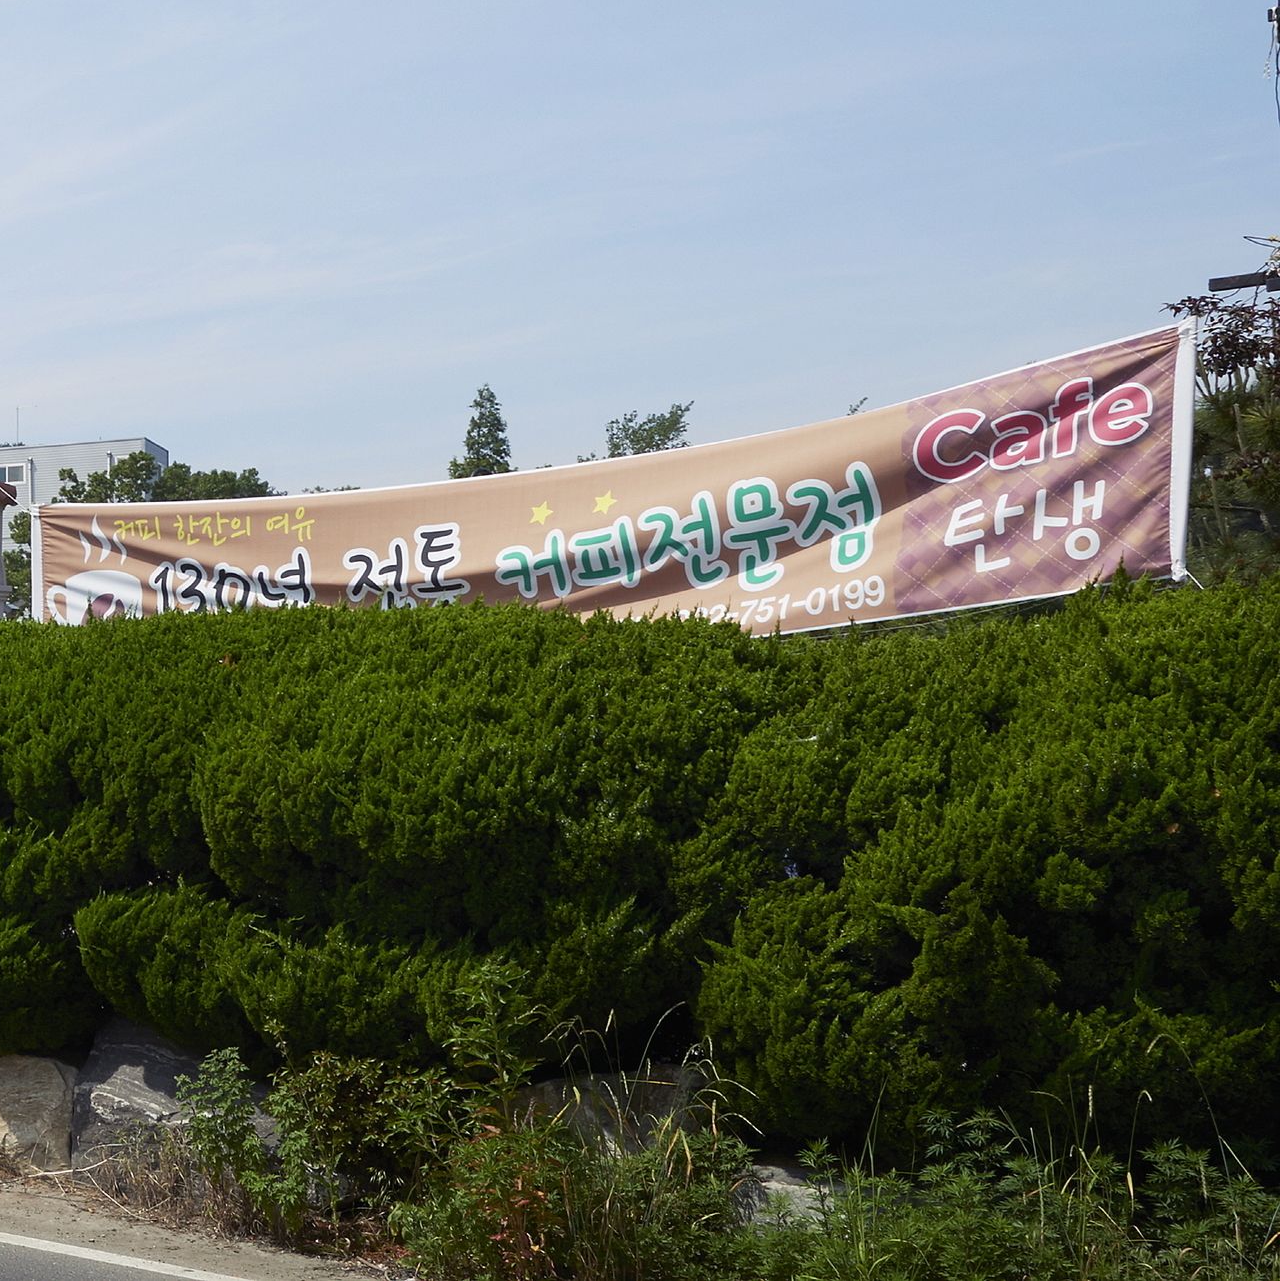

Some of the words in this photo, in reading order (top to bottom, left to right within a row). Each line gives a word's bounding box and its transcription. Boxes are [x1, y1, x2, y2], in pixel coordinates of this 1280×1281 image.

[913, 377, 1153, 483] Cafe
[114, 515, 161, 541] 커피
[173, 512, 252, 547] 한잔의
[266, 506, 315, 543] 여유
[943, 479, 1105, 574] 탄생
